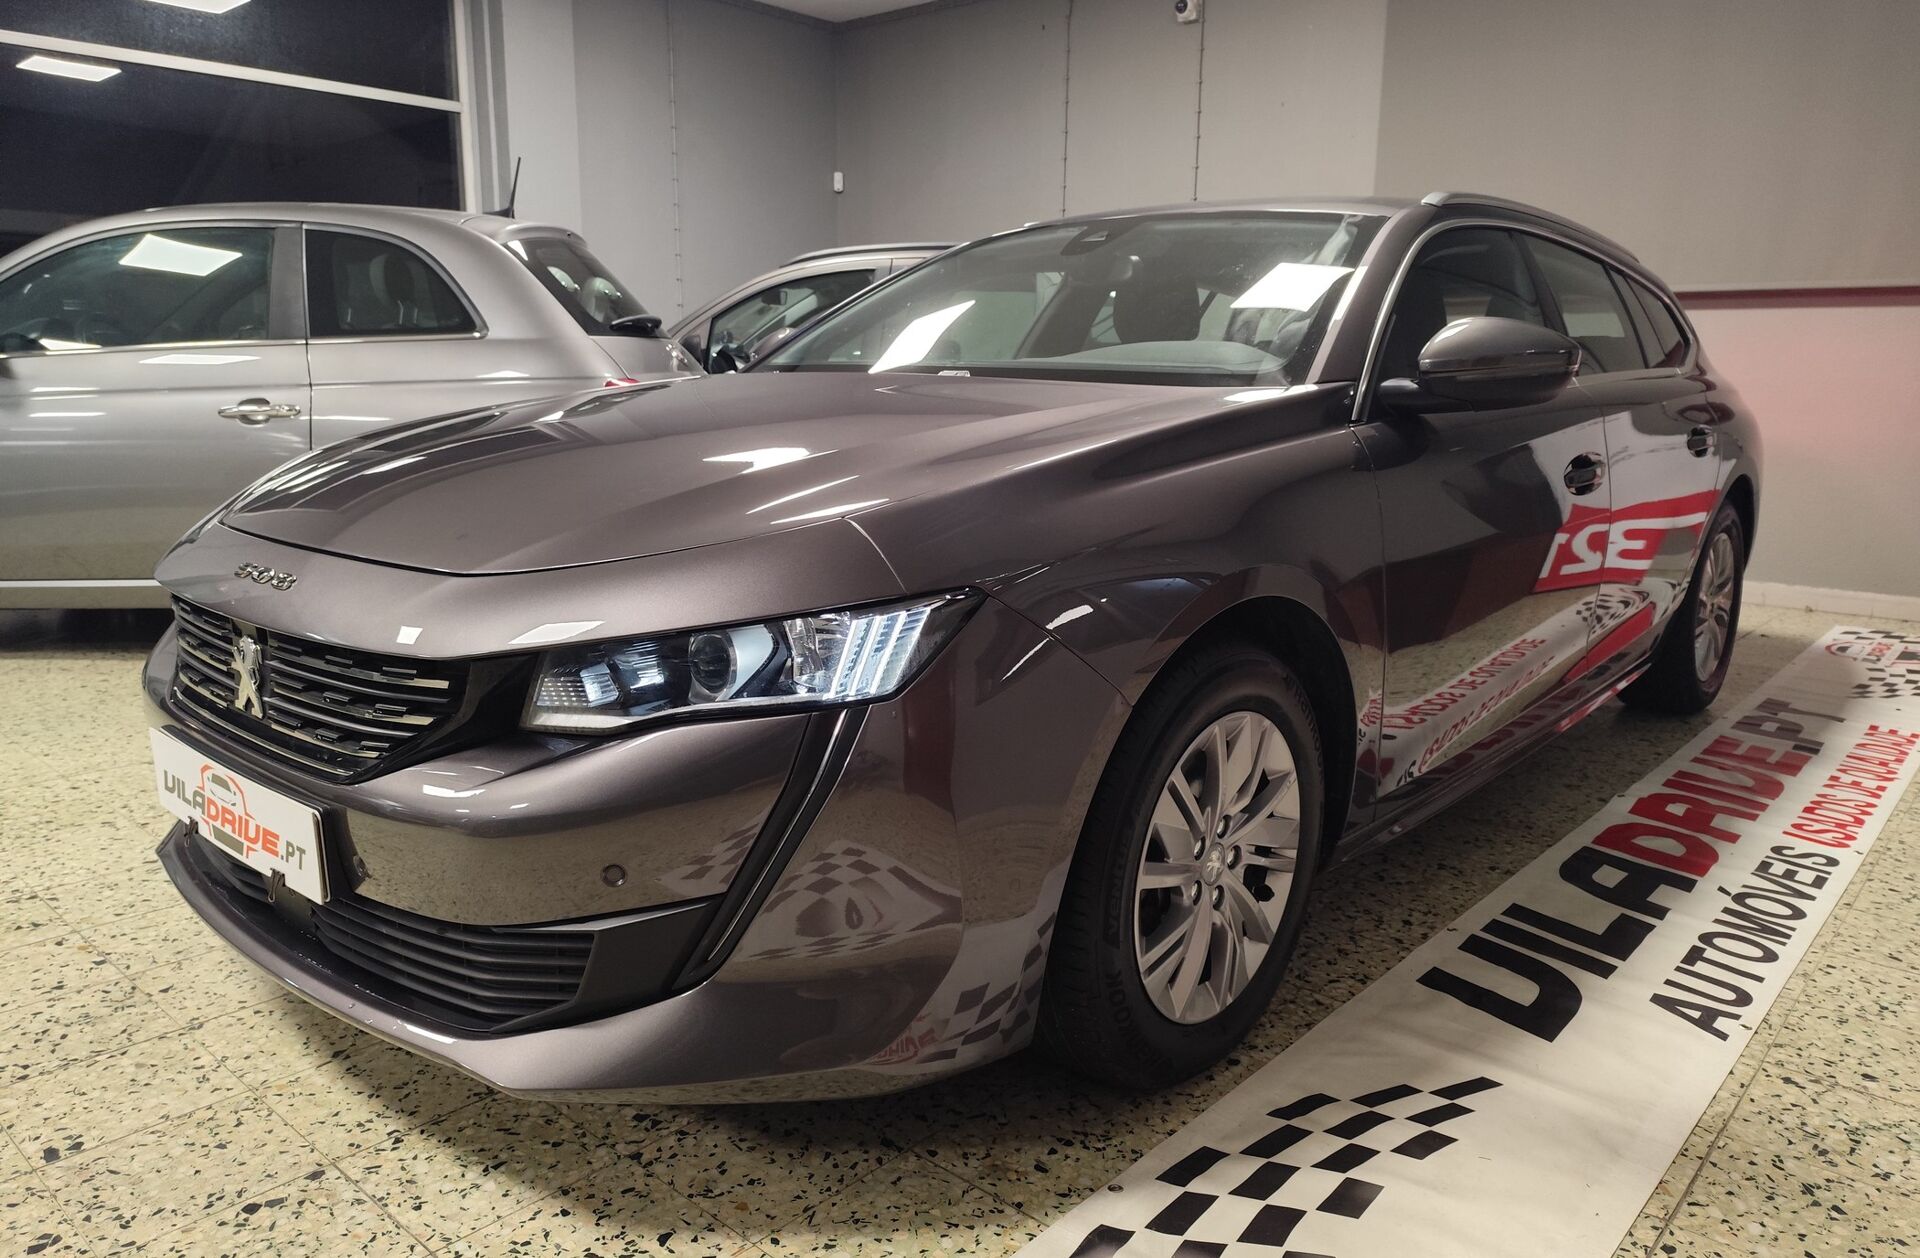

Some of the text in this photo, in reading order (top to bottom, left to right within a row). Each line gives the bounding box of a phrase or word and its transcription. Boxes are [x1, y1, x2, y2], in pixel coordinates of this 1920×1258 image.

[234, 562, 297, 591] 508
[164, 769, 306, 870] VILADRIVE.PT
[1649, 724, 1920, 1042] AUTOMÓVEIS USADOS DE QUALIDADE
